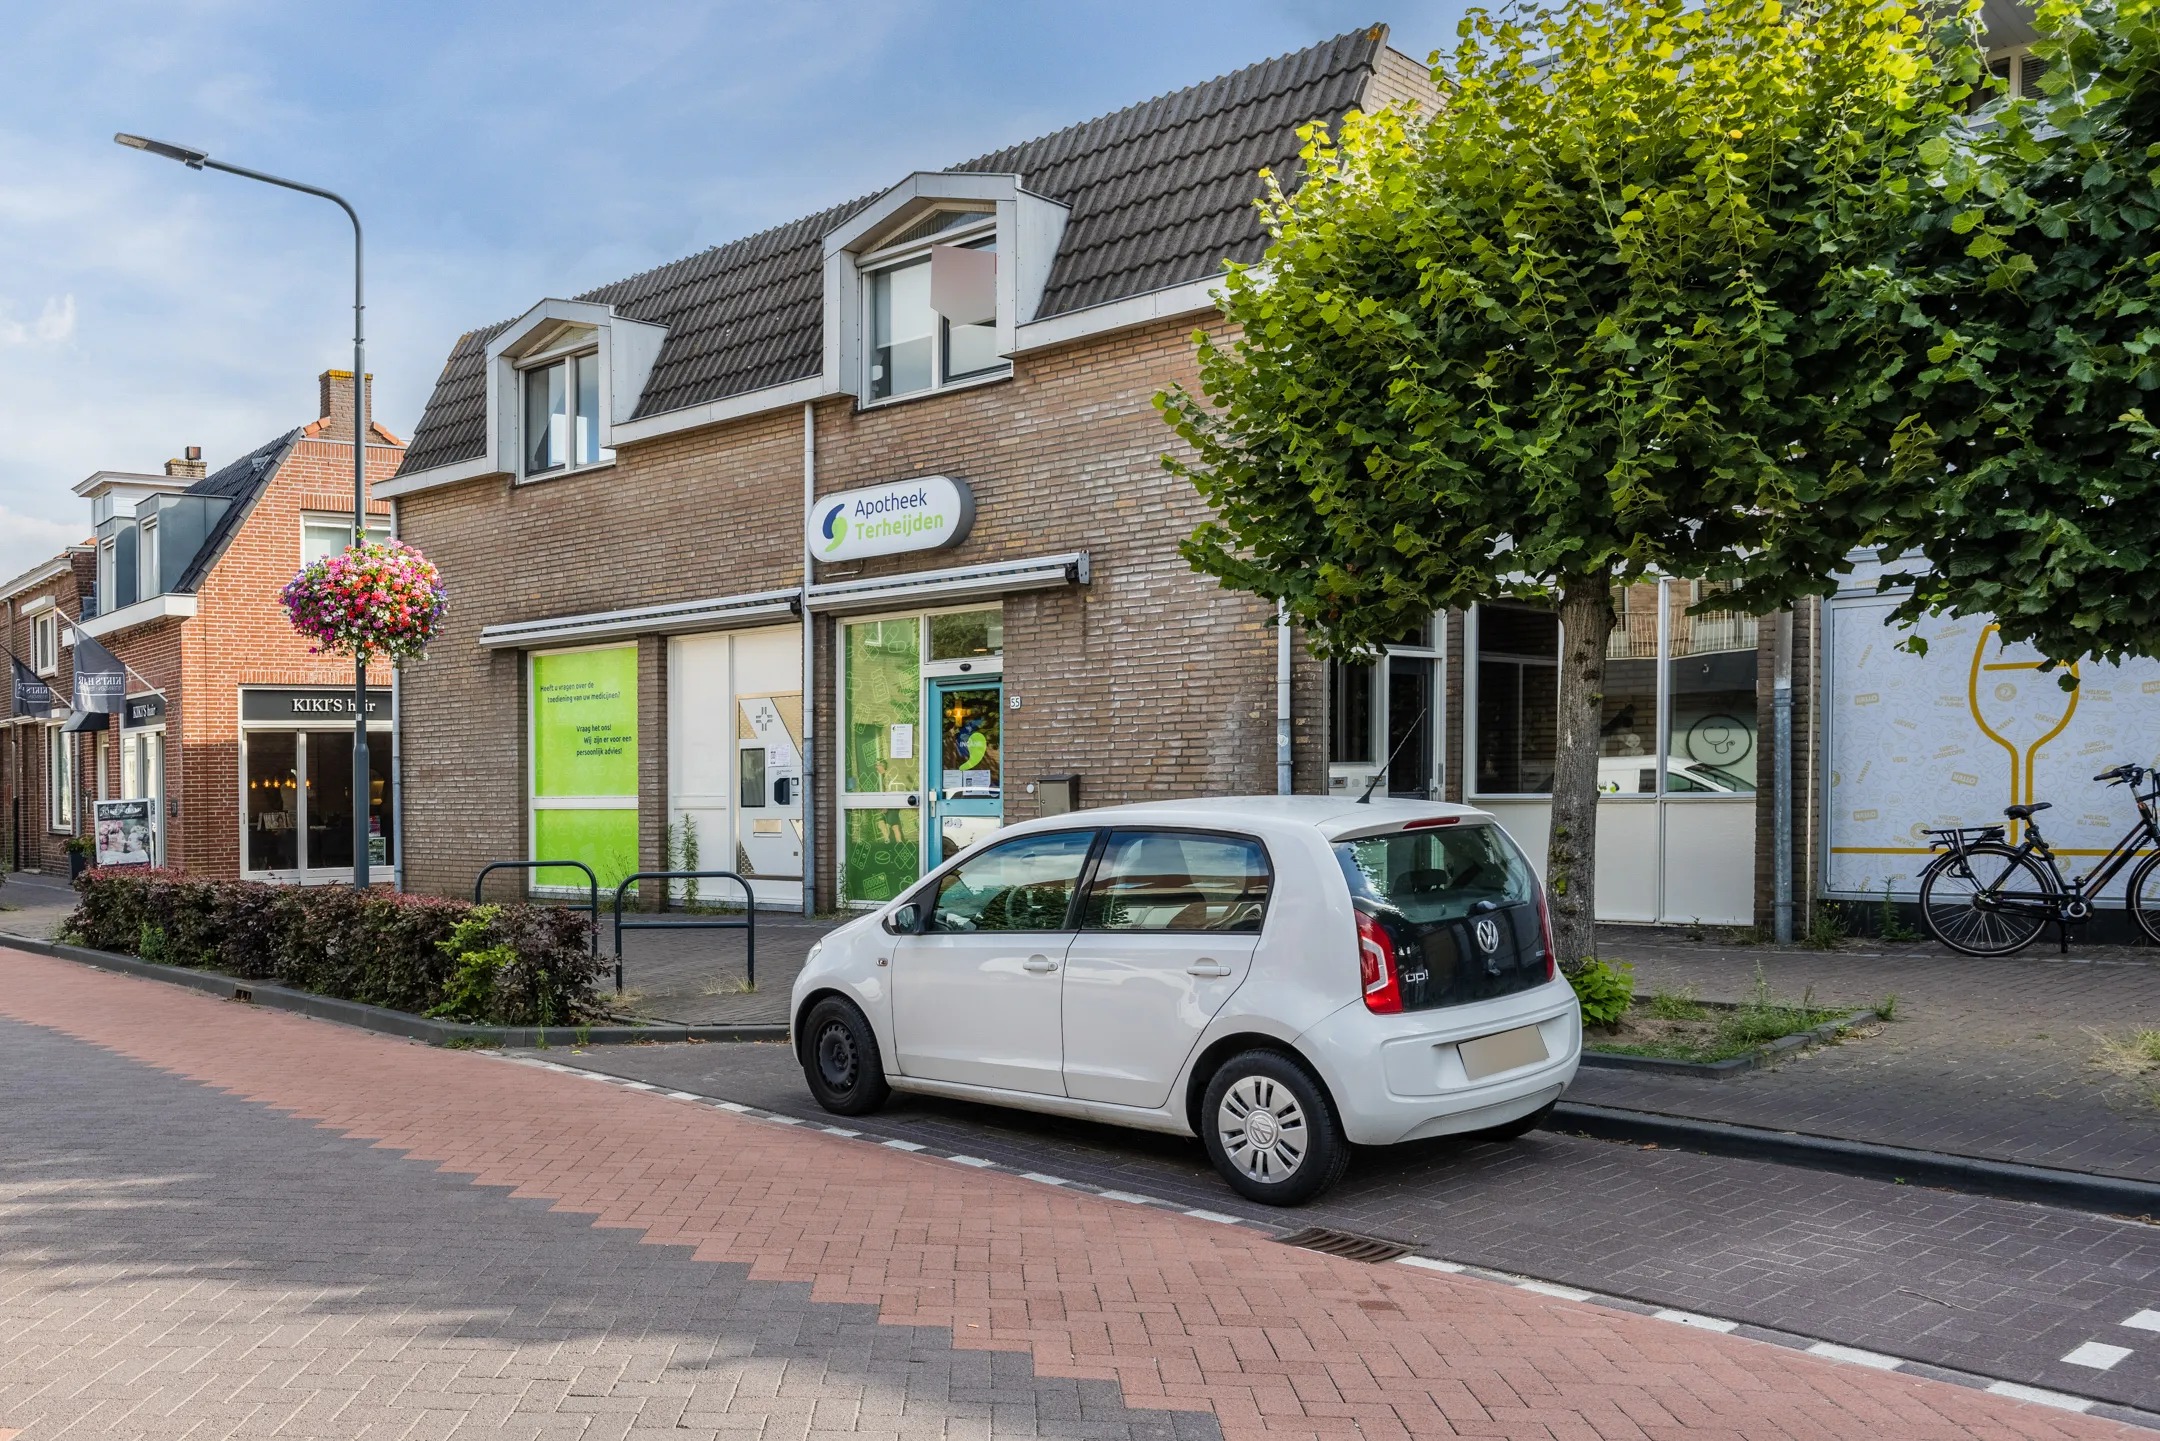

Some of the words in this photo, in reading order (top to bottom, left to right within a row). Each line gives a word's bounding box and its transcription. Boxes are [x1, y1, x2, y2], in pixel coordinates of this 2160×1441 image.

[855, 488, 927, 519] Apotheek
[855, 512, 944, 540] Terheijden
[559, 684, 575, 692] vragen
[587, 681, 594, 689] de
[547, 694, 573, 703] toediening
[591, 691, 620, 700] medicijnen?
[1011, 697, 1020, 708] 55
[293, 698, 343, 712] KIKI'S
[347, 698, 375, 712] hir
[576, 725, 591, 734] Vraag
[584, 736, 592, 745] Wij
[594, 736, 602, 744] zijn
[576, 747, 604, 756] persoonlijk
[604, 747, 623, 755] advies!
